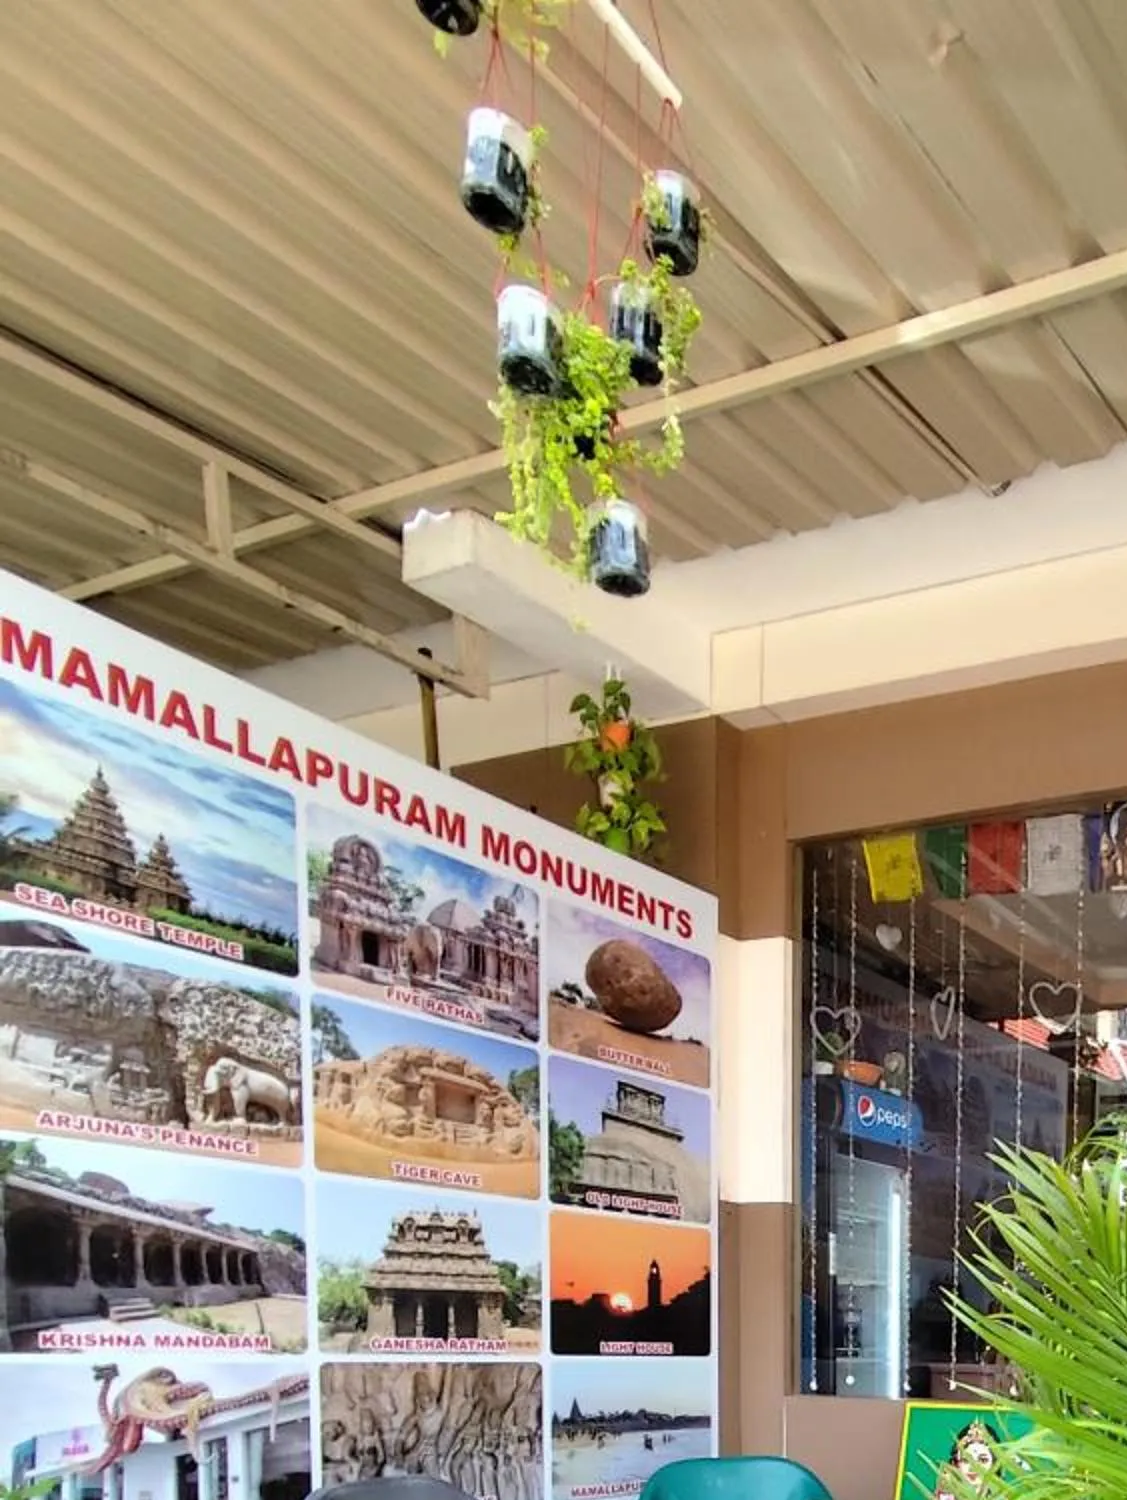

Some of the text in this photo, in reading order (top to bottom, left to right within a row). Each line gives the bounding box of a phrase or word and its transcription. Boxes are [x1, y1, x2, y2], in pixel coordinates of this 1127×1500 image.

[0, 617, 693, 939] MAMALLAPURAM MONUMENTS
[16, 883, 243, 959] SEA SHORE TEMPLE
[386, 986, 483, 1023] FIVE RATHAS
[38, 1110, 258, 1156] ARJUNA'S PENANCE
[393, 1162, 482, 1187] TIGER CAVE
[39, 1331, 271, 1350] KRISHNA MANDABAM
[371, 1336, 508, 1352] GANESHA RATHAM
